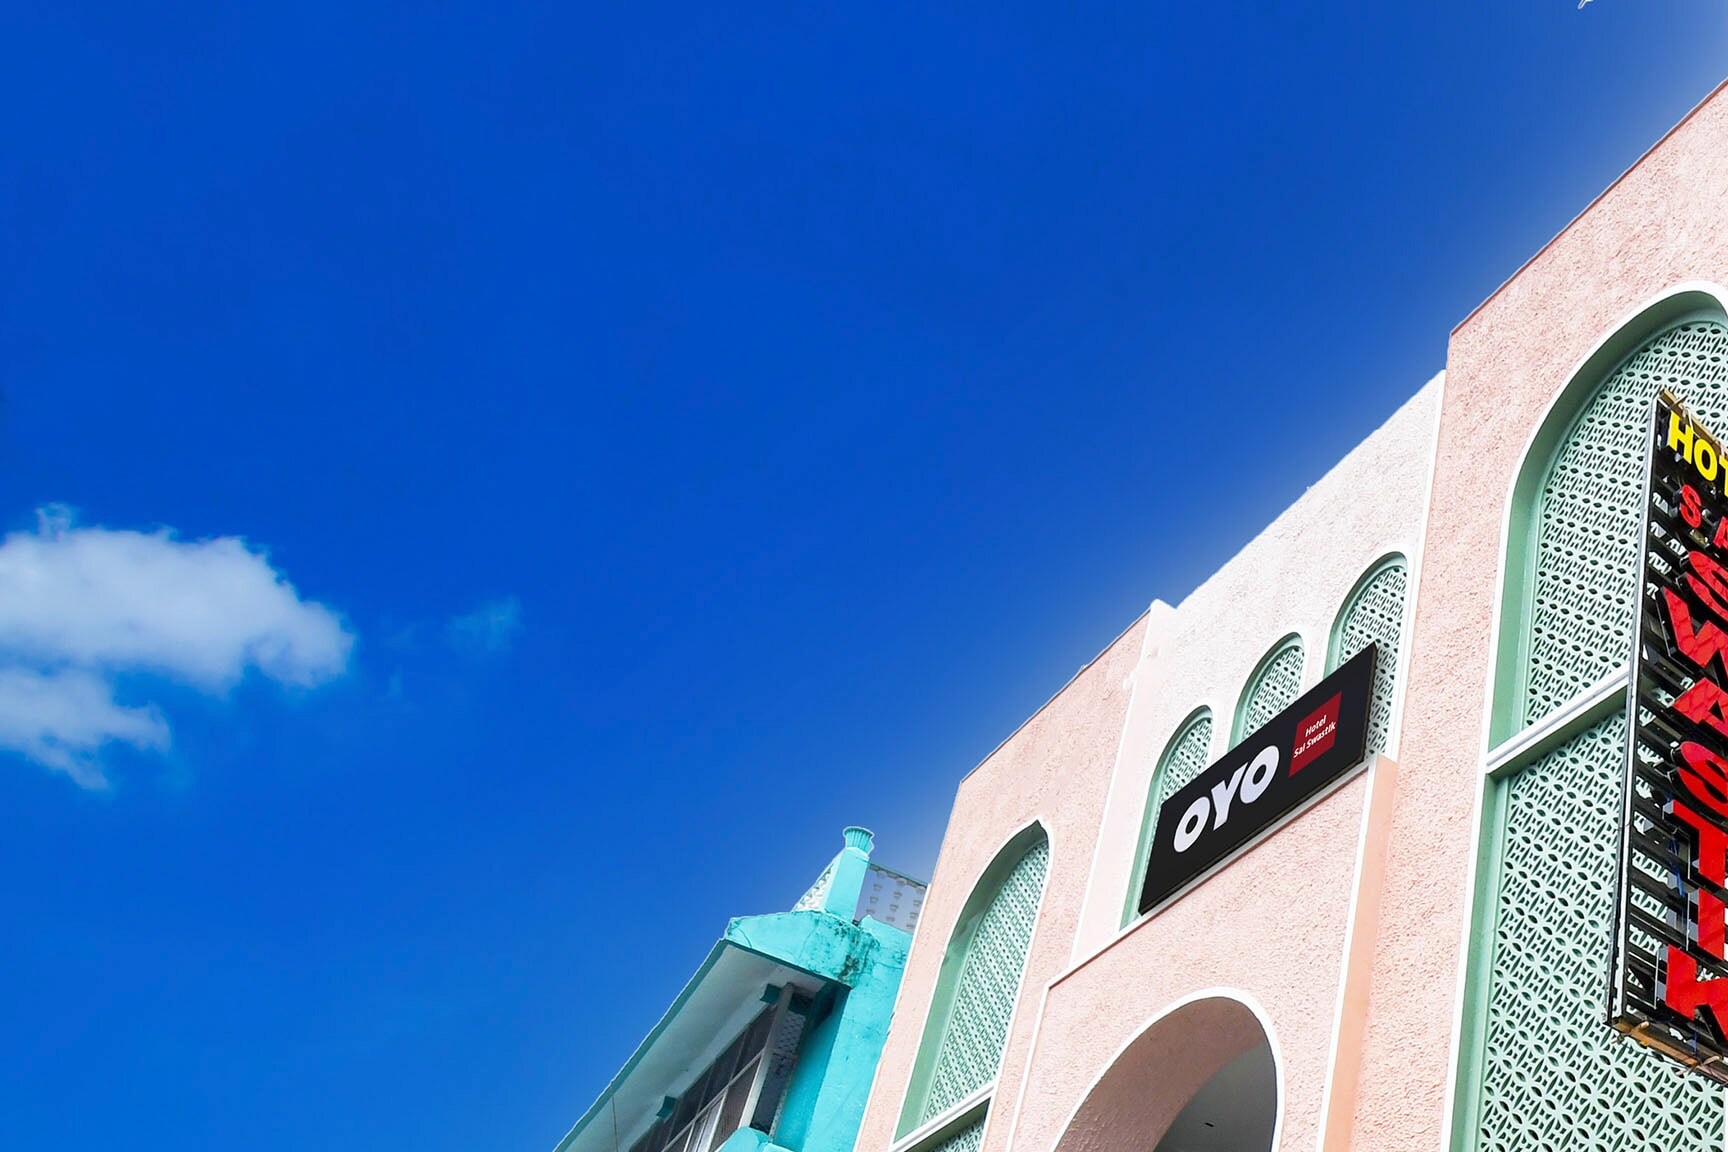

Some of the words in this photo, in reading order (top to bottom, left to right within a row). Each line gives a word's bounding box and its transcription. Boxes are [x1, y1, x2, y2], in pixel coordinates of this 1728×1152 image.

[1293, 743, 1306, 759] Sai
[1306, 721, 1337, 749] Swastik
[1305, 714, 1327, 738] Hotel
[1173, 745, 1280, 853] OYO
